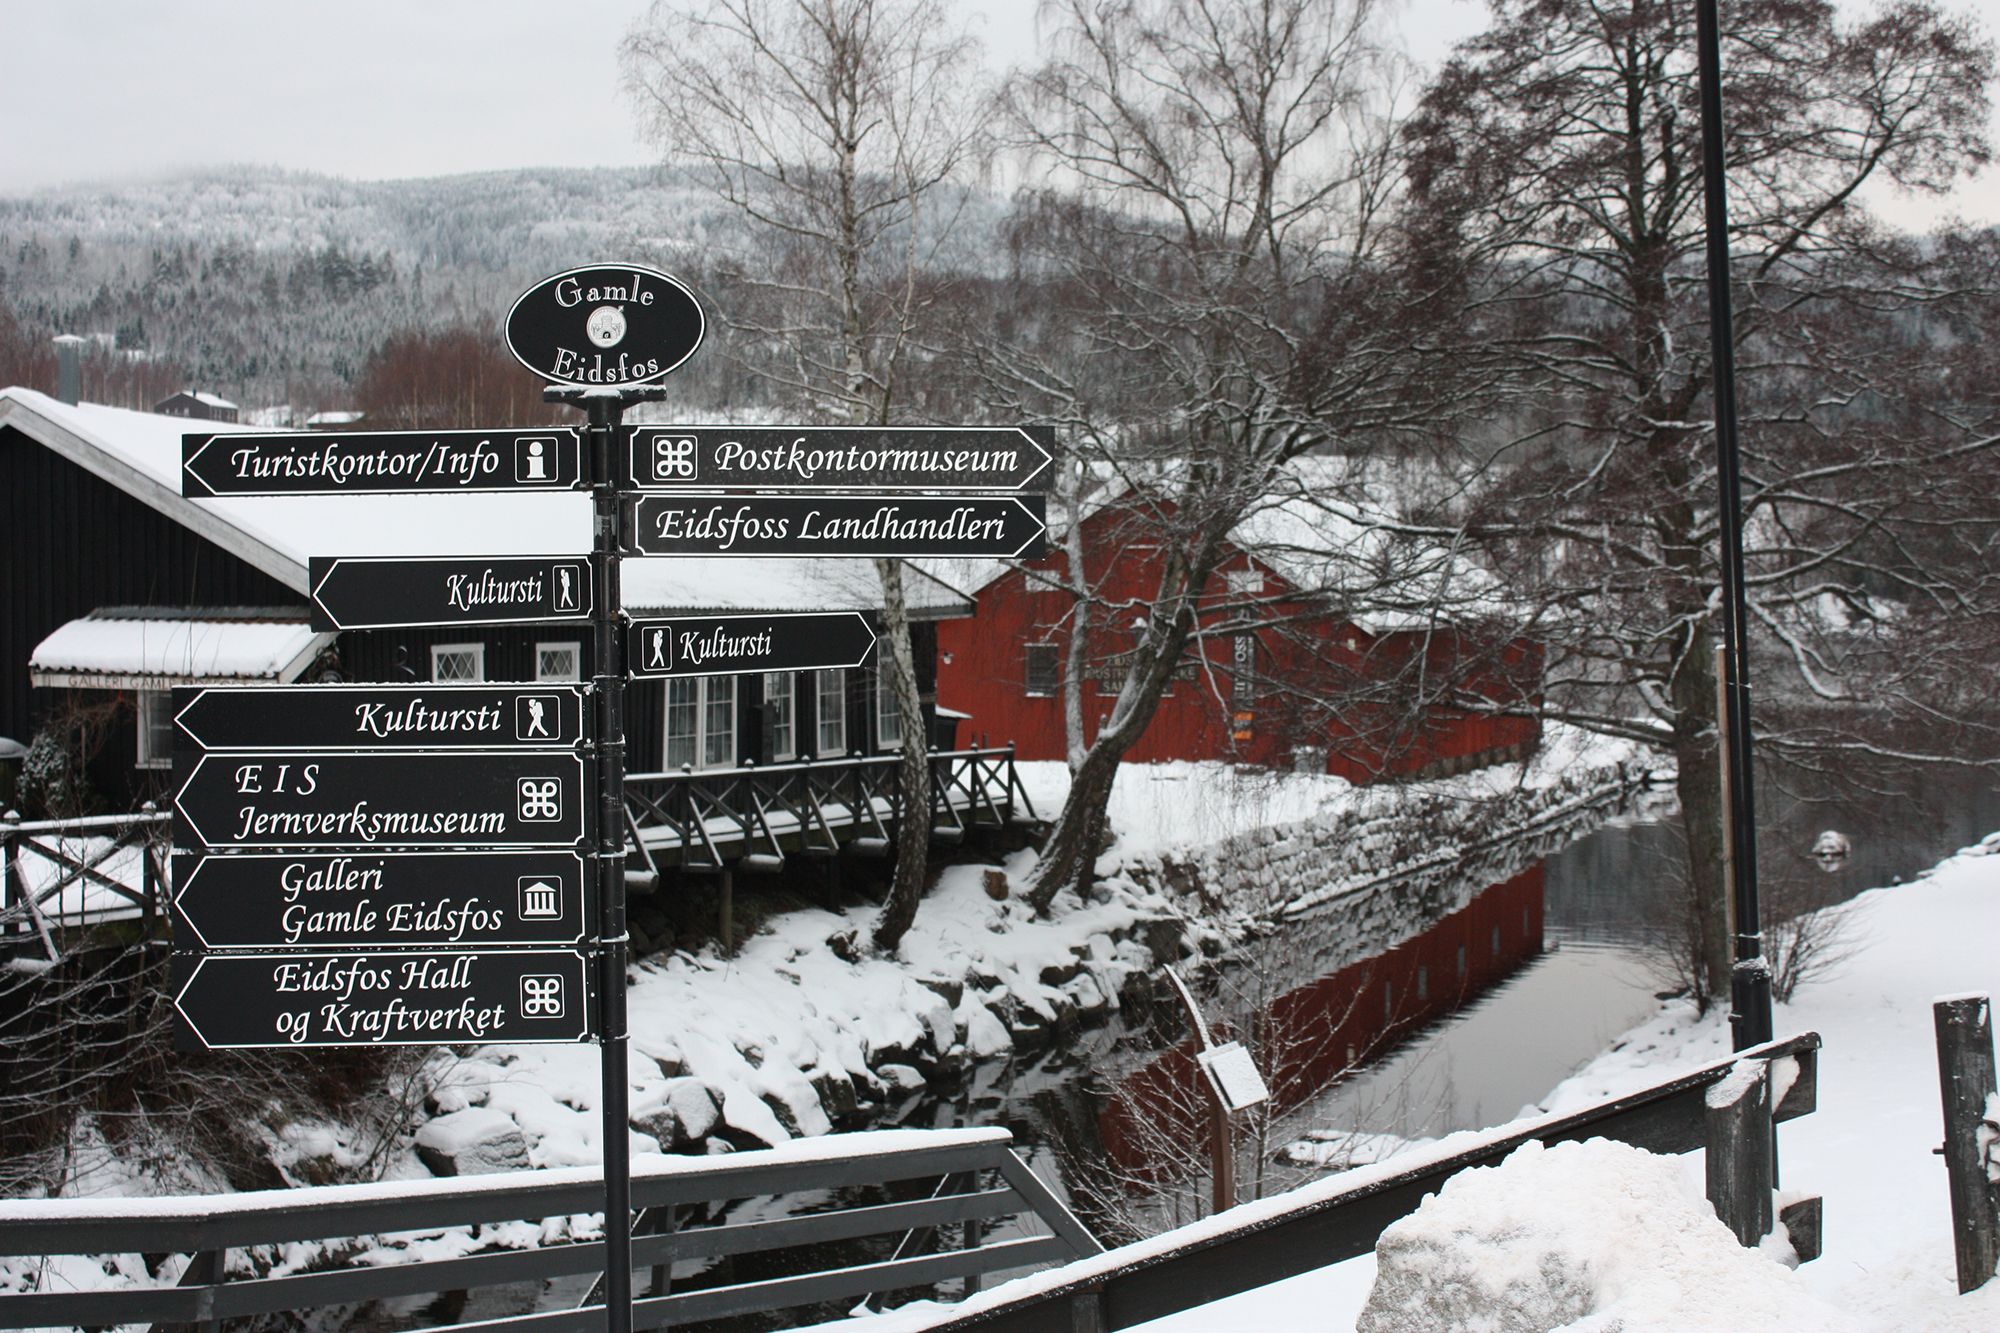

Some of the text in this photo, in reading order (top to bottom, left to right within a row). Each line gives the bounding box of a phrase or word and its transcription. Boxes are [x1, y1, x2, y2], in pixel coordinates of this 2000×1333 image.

[554, 274, 655, 308] Gamle
[550, 346, 660, 383] Eidsfos
[231, 440, 500, 485] Turistkontor/Info
[714, 437, 1019, 479] Postkontormuseum
[655, 505, 1007, 549] Eidsfoss Landhandleri
[446, 568, 543, 611] Kultursti
[679, 625, 773, 665] Kultursti
[355, 698, 502, 738] Kultursti
[233, 801, 506, 842] Jernverksmuseum
[280, 858, 385, 902] Galleri
[281, 898, 504, 944] Gamle Eidsfos
[273, 955, 479, 1001] Eidsfos Hall
[275, 997, 505, 1043] og Kraftverket
